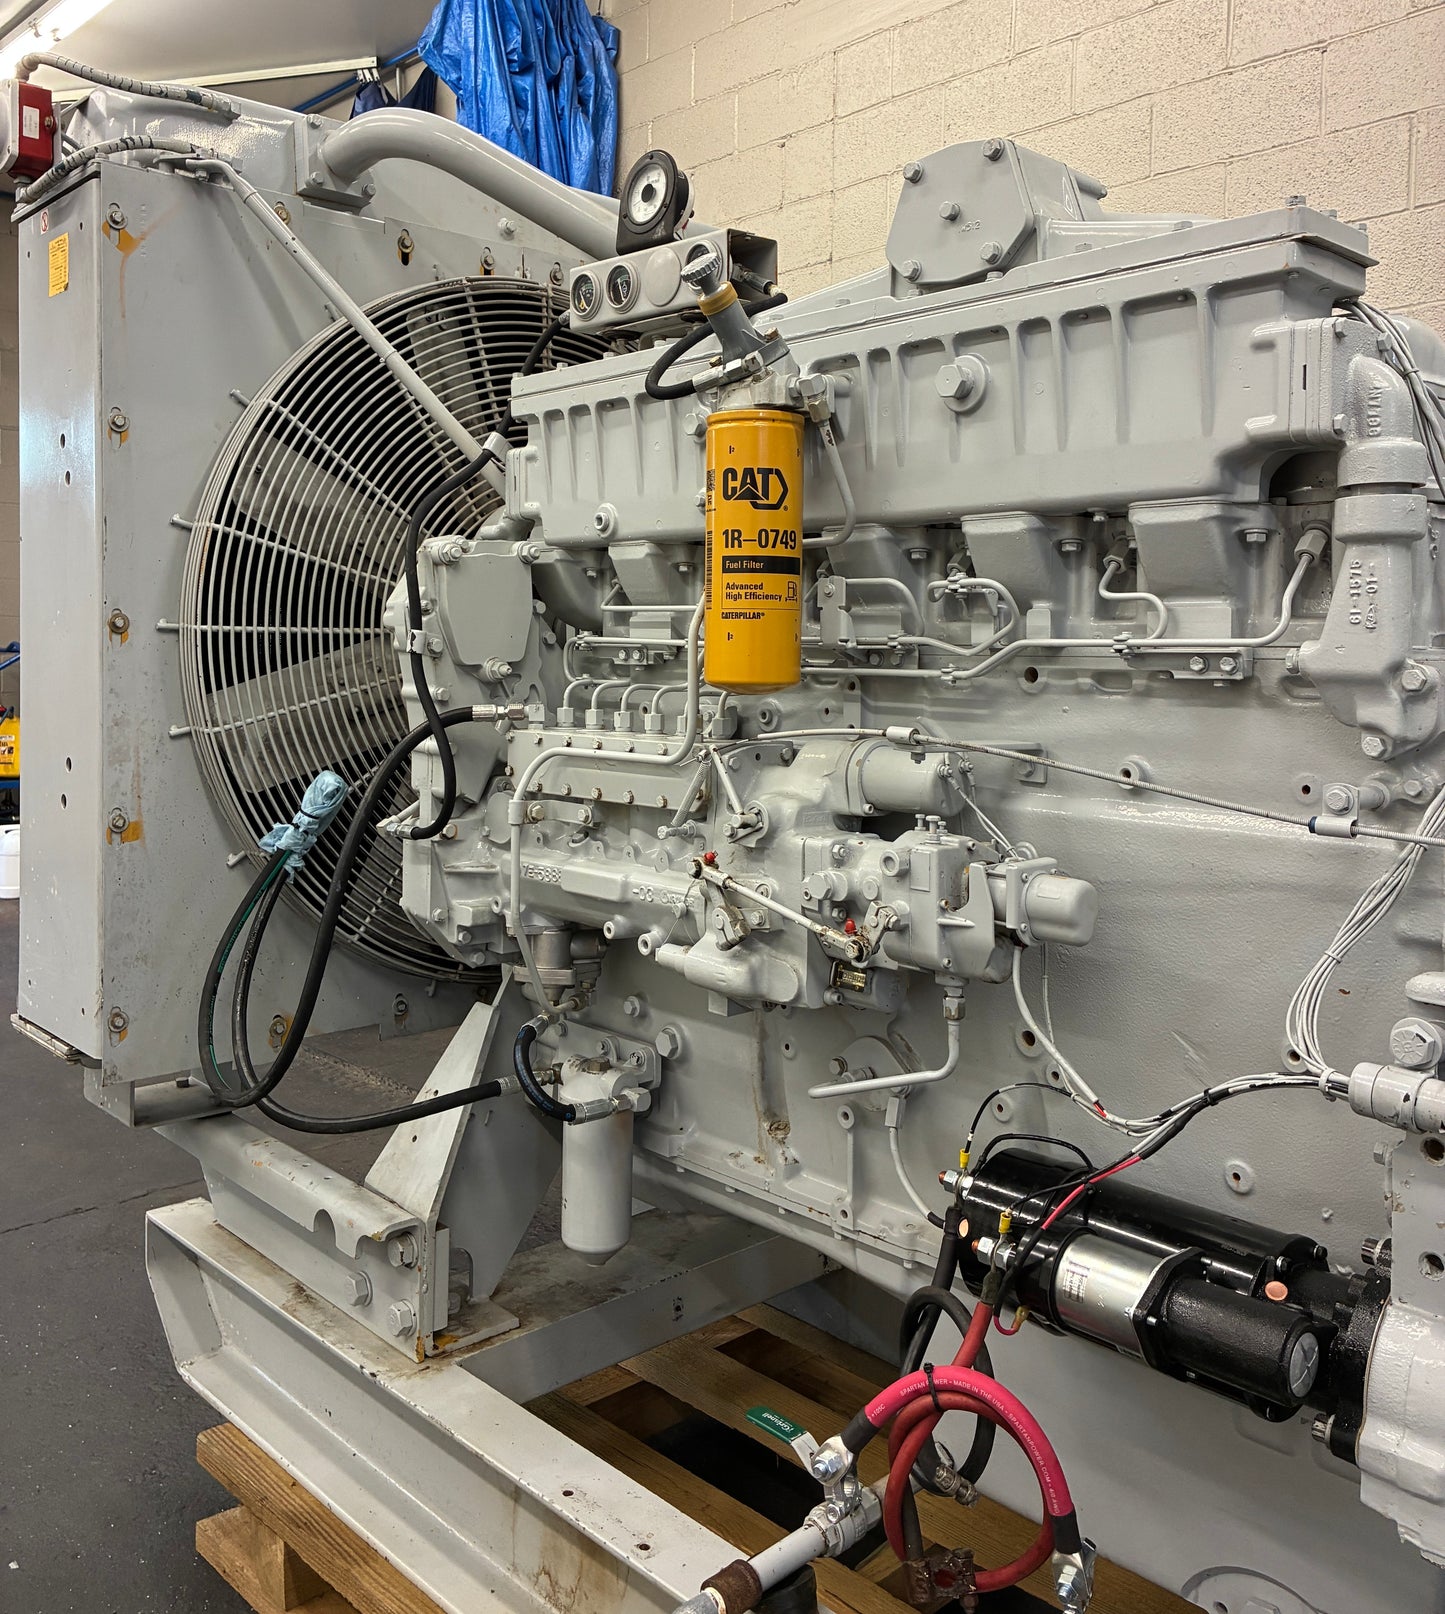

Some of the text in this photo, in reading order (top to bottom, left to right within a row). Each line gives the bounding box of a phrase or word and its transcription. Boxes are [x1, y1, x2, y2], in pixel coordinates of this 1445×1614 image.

[723, 467, 774, 501] CAT
[725, 560, 764, 569] Fuel Filter
[725, 582, 764, 591] Advanced
[725, 592, 782, 602] High Efficiency
[900, 1381, 926, 1397] SPARTAN
[926, 1378, 948, 1386] PWER
[953, 1379, 971, 1390] MADE
[971, 1385, 979, 1393] IN
[980, 1389, 992, 1400] THE
[992, 1398, 1005, 1411] USA
